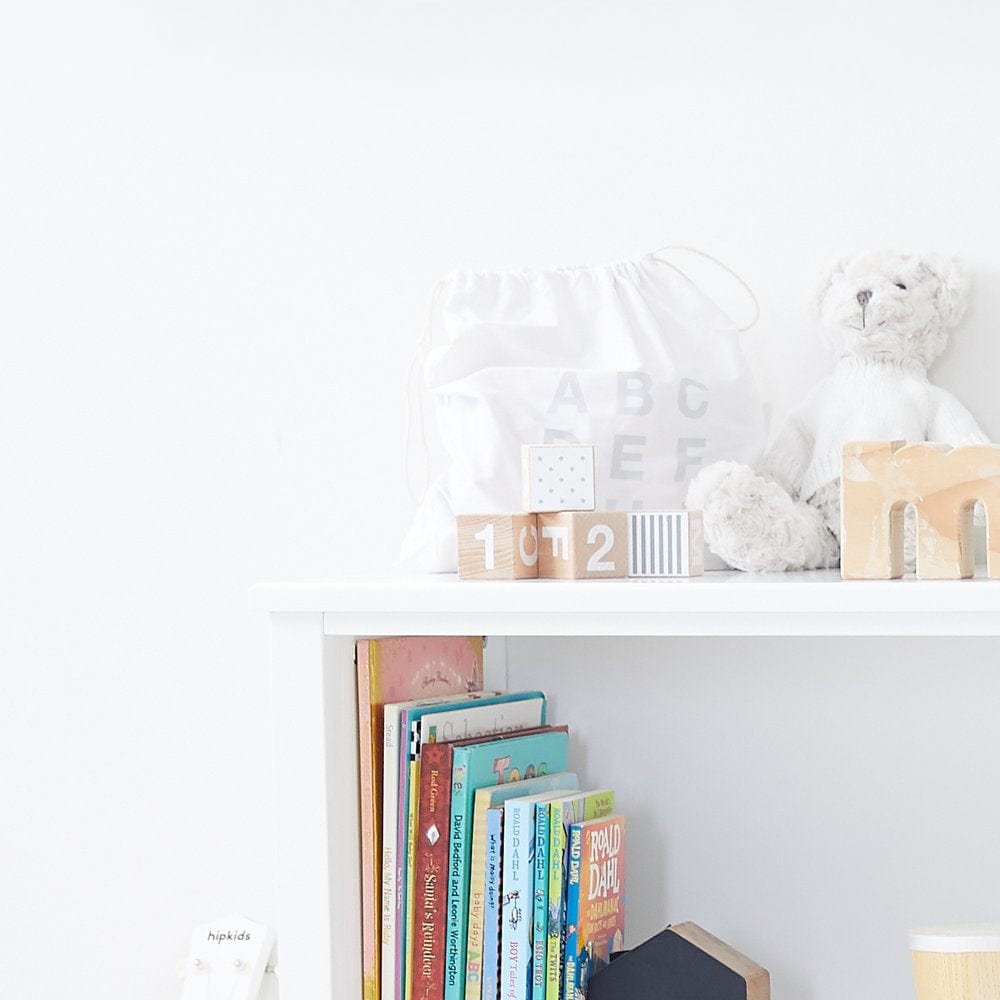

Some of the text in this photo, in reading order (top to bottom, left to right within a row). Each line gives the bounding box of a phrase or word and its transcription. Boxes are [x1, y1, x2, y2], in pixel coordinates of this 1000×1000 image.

[547, 371, 710, 419] A B C
[609, 435, 647, 481] E
[475, 523, 495, 570] 1
[586, 524, 615, 571] 2
[429, 788, 439, 812] Green
[512, 808, 521, 881] ROALD DAHL
[537, 807, 546, 881] ROALD DAHL
[589, 824, 621, 862] ROALD
[569, 860, 580, 885] DAHL
[588, 858, 620, 900] DAHL
[447, 815, 463, 986] David Bedford and Leonie Worthington
[207, 930, 251, 944] hipkids
[422, 873, 438, 978] Santa's Reindeer
[467, 892, 482, 982] baby days ABC
[509, 941, 519, 963] BOY
[549, 953, 558, 982] TWITS
[509, 964, 518, 987] Tales
